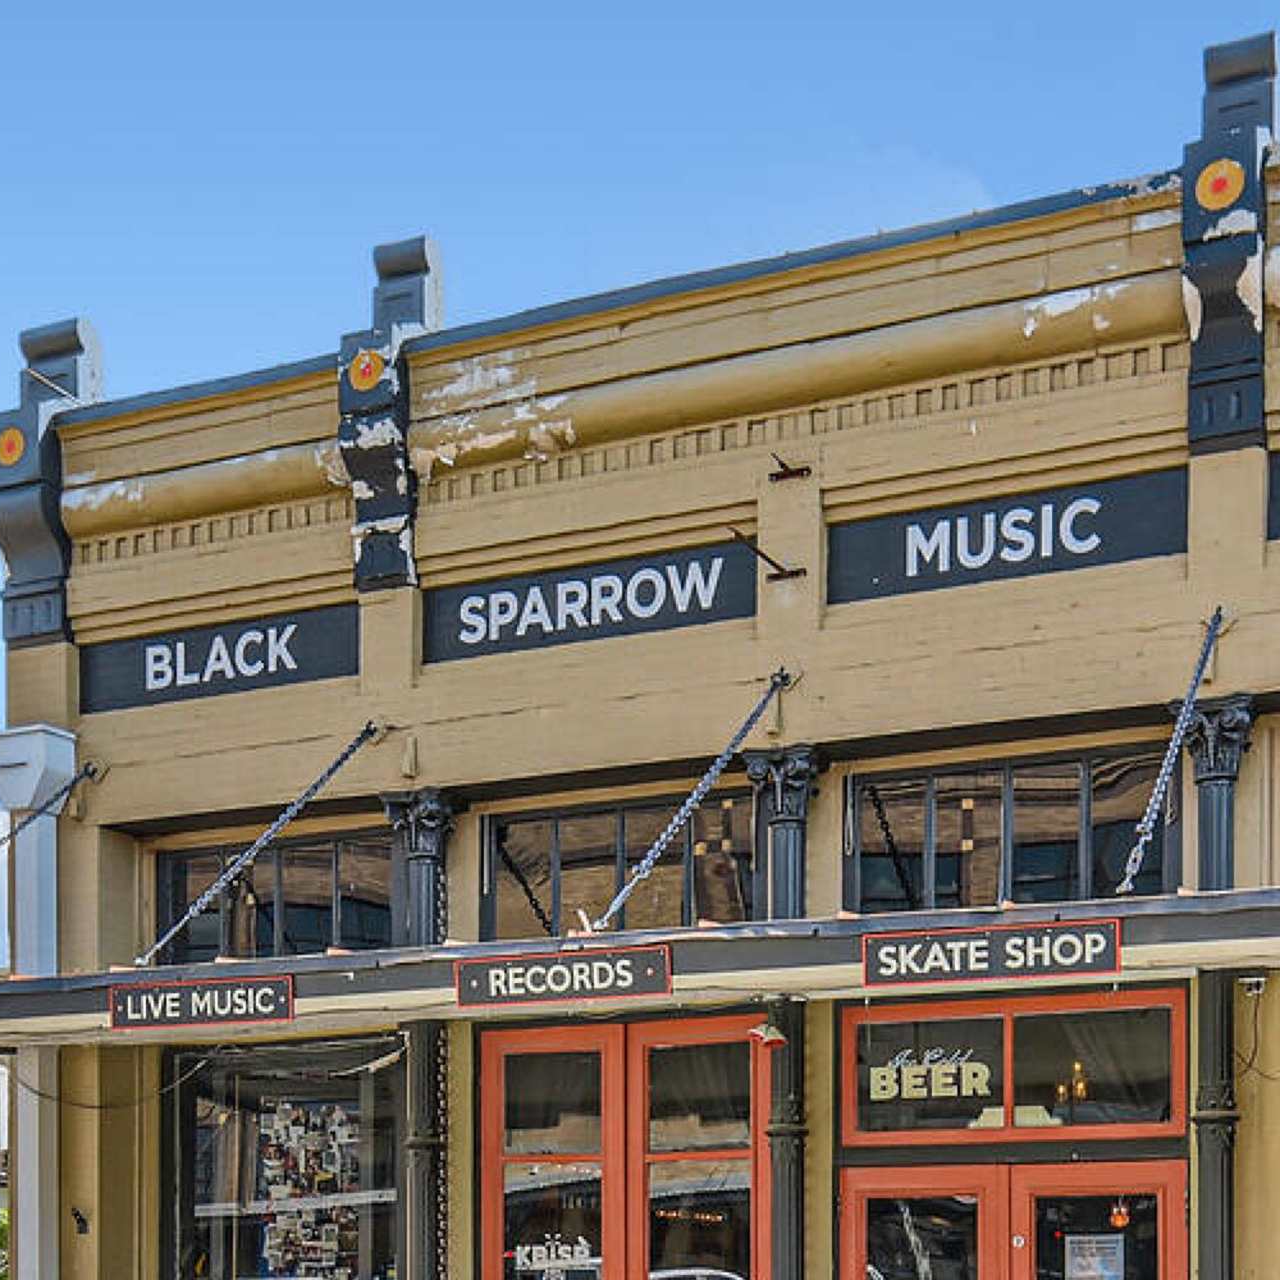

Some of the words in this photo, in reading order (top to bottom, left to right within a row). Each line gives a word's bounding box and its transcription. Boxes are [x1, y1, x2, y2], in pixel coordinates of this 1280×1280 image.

[144, 624, 297, 690] BLACK
[459, 557, 723, 644] SPARROW
[904, 498, 1102, 577] MUSIC
[877, 939, 990, 976] SKATE
[1005, 933, 1107, 969] SHOP
[488, 960, 634, 996] RECORDS
[127, 991, 181, 1020] LIVE
[190, 987, 275, 1018] MUSIC
[870, 1062, 991, 1100] BEER
